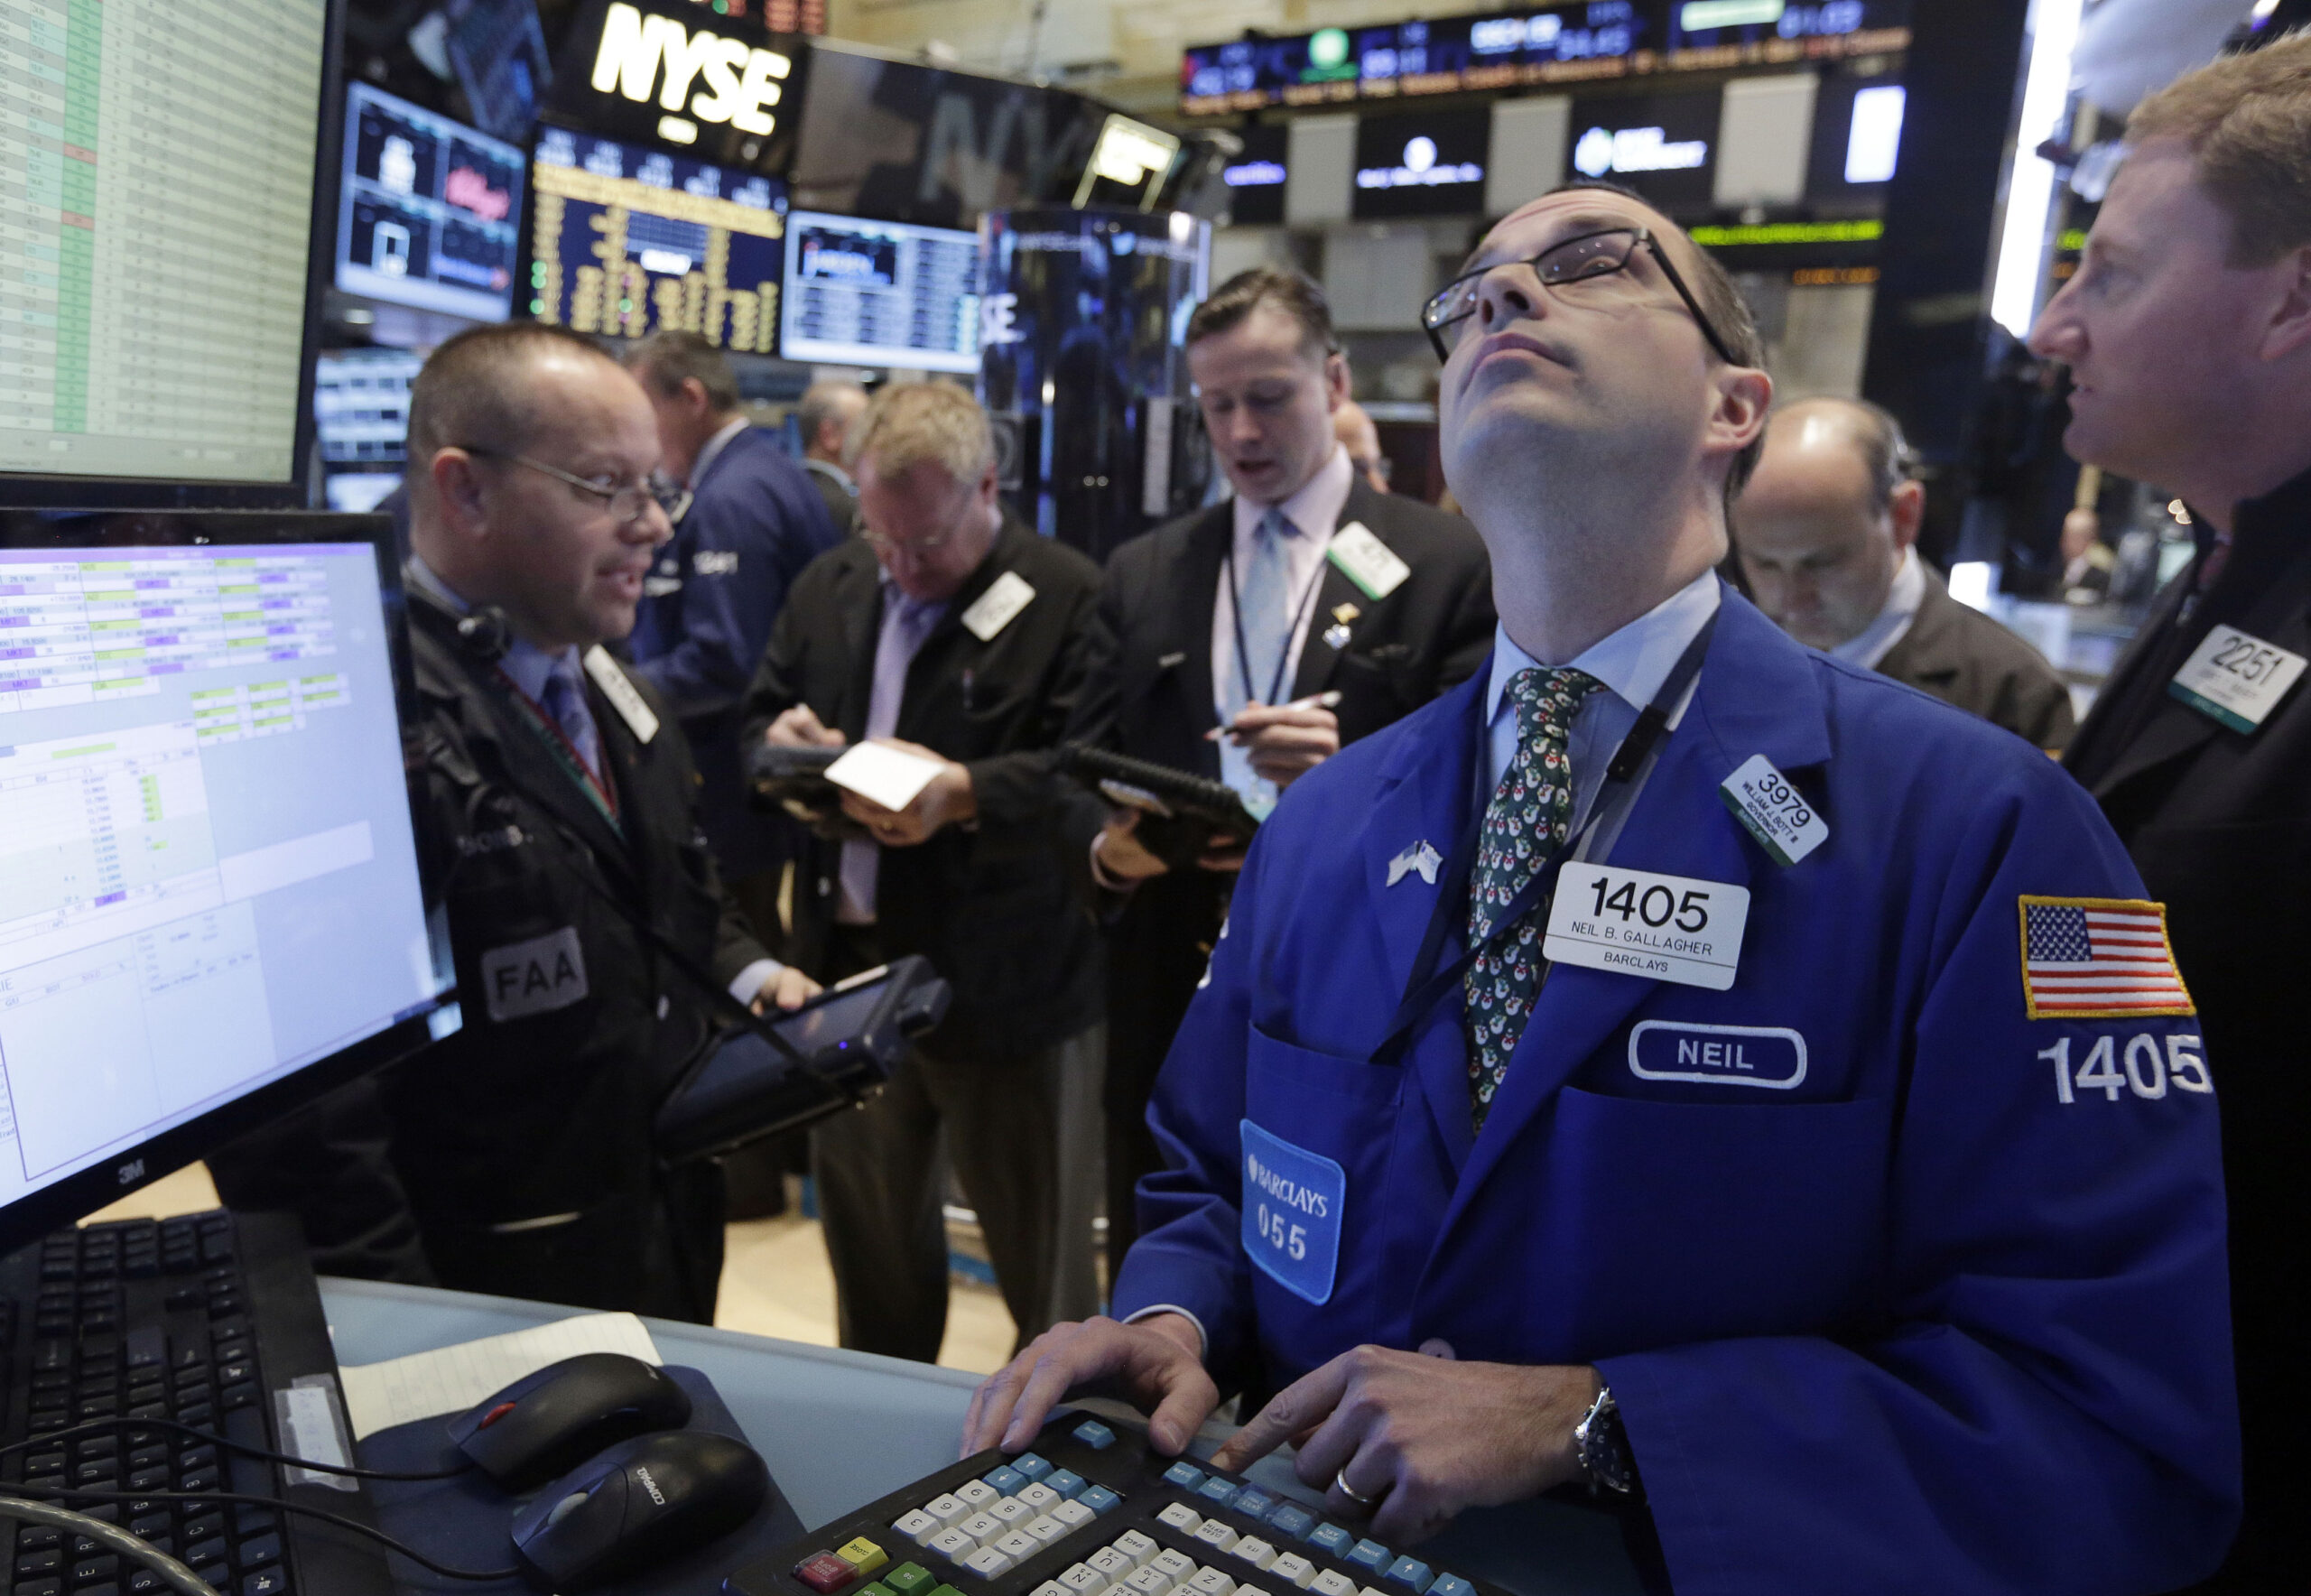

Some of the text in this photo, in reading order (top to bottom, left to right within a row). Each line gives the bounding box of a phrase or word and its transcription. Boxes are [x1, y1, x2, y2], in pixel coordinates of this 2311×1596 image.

[591, 2, 792, 135] NYSE
[2212, 635, 2284, 686] 2251
[1759, 773, 1811, 828] 3979
[1742, 781, 1769, 811] WILLIAM
[1772, 816, 1795, 836] BOTT
[1746, 801, 1778, 836] GOVERNOR
[1591, 877, 1710, 933] 1405
[1572, 921, 1712, 955] NEIL B. GALLAGHER
[1604, 951, 1668, 973] BARCLAYS
[496, 951, 577, 1001] FAA
[1677, 1038, 1754, 1071] NEIL
[2037, 1033, 2214, 1104] 1405
[118, 1159, 144, 1184] 3M
[1258, 1164, 1328, 1219] BARCLAYS
[1258, 1202, 1307, 1261] 055
[185, 1480, 200, 1488] B
[636, 1467, 665, 1505] COMPAQ
[940, 1502, 952, 1510] 6
[1004, 1505, 1016, 1513] 8
[1170, 1511, 1184, 1519] CAP
[910, 1518, 923, 1526] 3
[975, 1521, 987, 1529] 5
[189, 1526, 204, 1536] C
[1037, 1525, 1051, 1533] 7
[944, 1536, 958, 1545] 2
[1124, 1536, 1146, 1549] SPACE
[79, 1542, 95, 1551] R
[849, 1544, 869, 1555] CLOSE
[1246, 1545, 1259, 1553] ITS
[1358, 1545, 1380, 1558] SUMM
[191, 1552, 207, 1561] X
[1162, 1556, 1182, 1567] BKSP
[1099, 1558, 1113, 1567] U
[1282, 1560, 1298, 1571] TICK
[79, 1569, 95, 1577] E
[1072, 1573, 1086, 1583] N
[135, 1580, 151, 1589] S
[1137, 1577, 1149, 1585] T
[1202, 1574, 1217, 1584] Z
[1325, 1578, 1339, 1588] CXL
